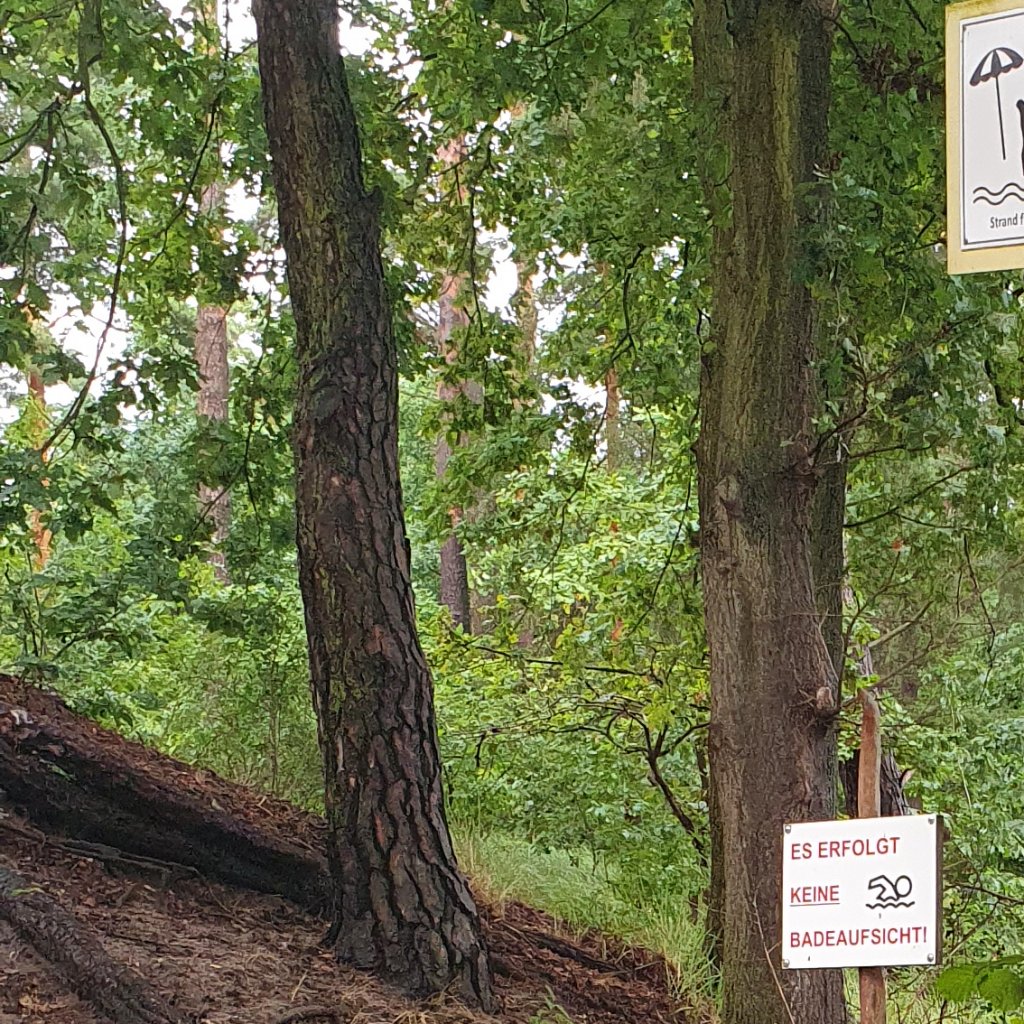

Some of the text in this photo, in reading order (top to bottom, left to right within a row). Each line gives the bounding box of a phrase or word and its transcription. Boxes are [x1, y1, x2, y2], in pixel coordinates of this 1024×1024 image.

[990, 213, 1018, 229] Strand
[791, 837, 900, 860] ES ERFOLGT
[790, 885, 840, 903] KEINE
[790, 926, 927, 948] BADEAUFSICHT!
